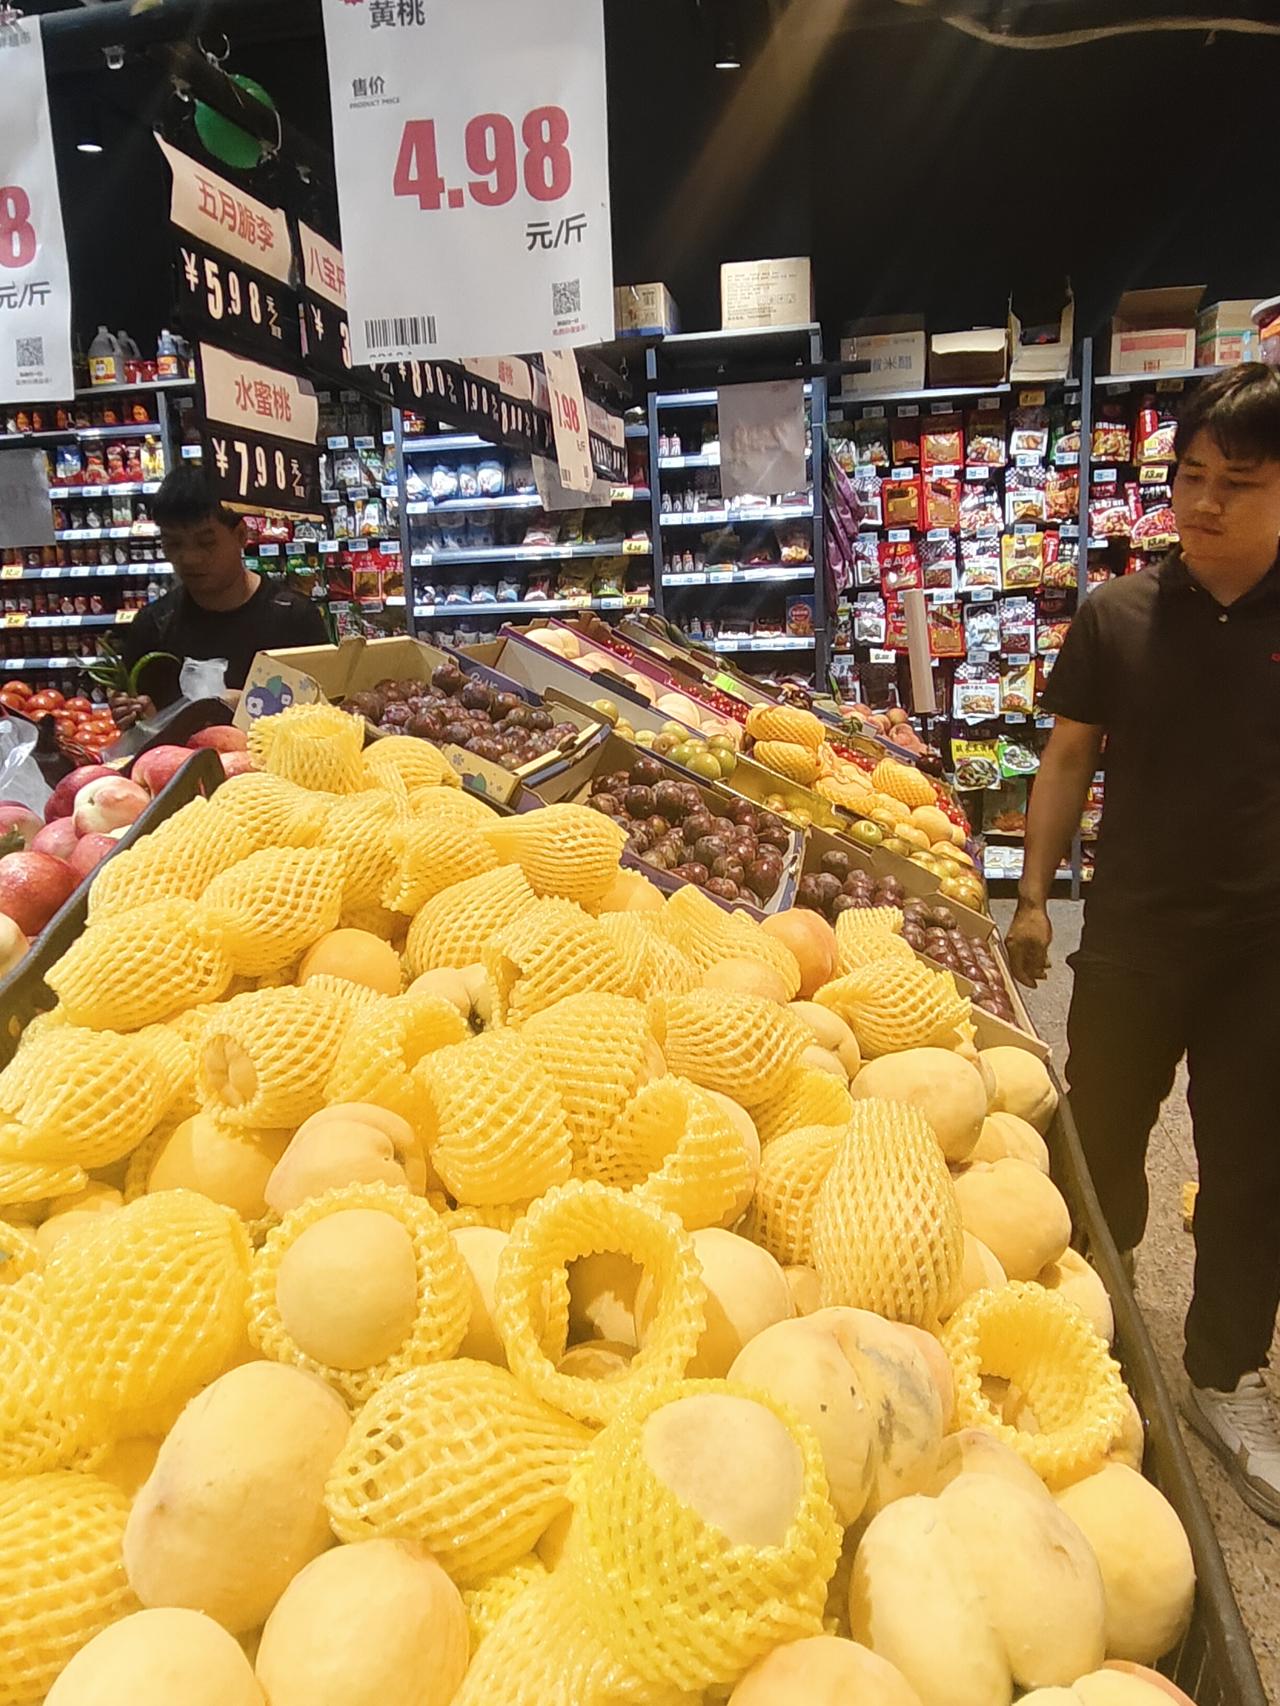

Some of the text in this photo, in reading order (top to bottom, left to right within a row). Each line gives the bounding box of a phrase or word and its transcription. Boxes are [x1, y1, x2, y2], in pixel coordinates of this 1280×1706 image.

[369, 0, 425, 28] 黄桃
[352, 76, 385, 97] 售价
[393, 105, 573, 210] 4.98
[195, 174, 275, 252] 五月脆李
[526, 213, 588, 251] 元/斤
[235, 374, 292, 422] 水蜜桃
[554, 390, 581, 433] 1.98
